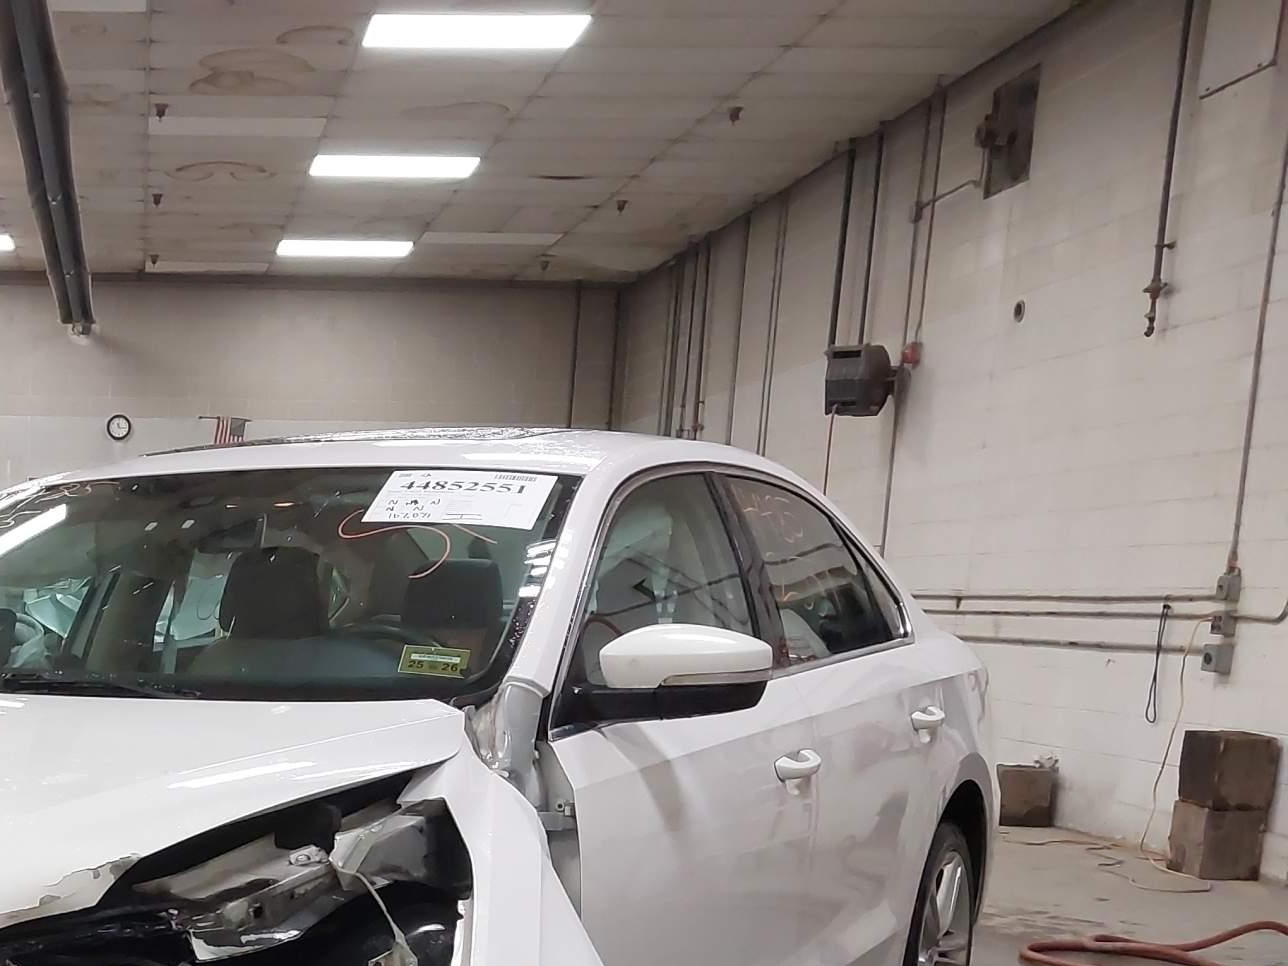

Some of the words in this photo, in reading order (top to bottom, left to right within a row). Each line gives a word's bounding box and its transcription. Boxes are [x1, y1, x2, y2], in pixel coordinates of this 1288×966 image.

[400, 480, 526, 494] 44852551
[407, 660, 424, 669] 25
[441, 663, 458, 672] 26
